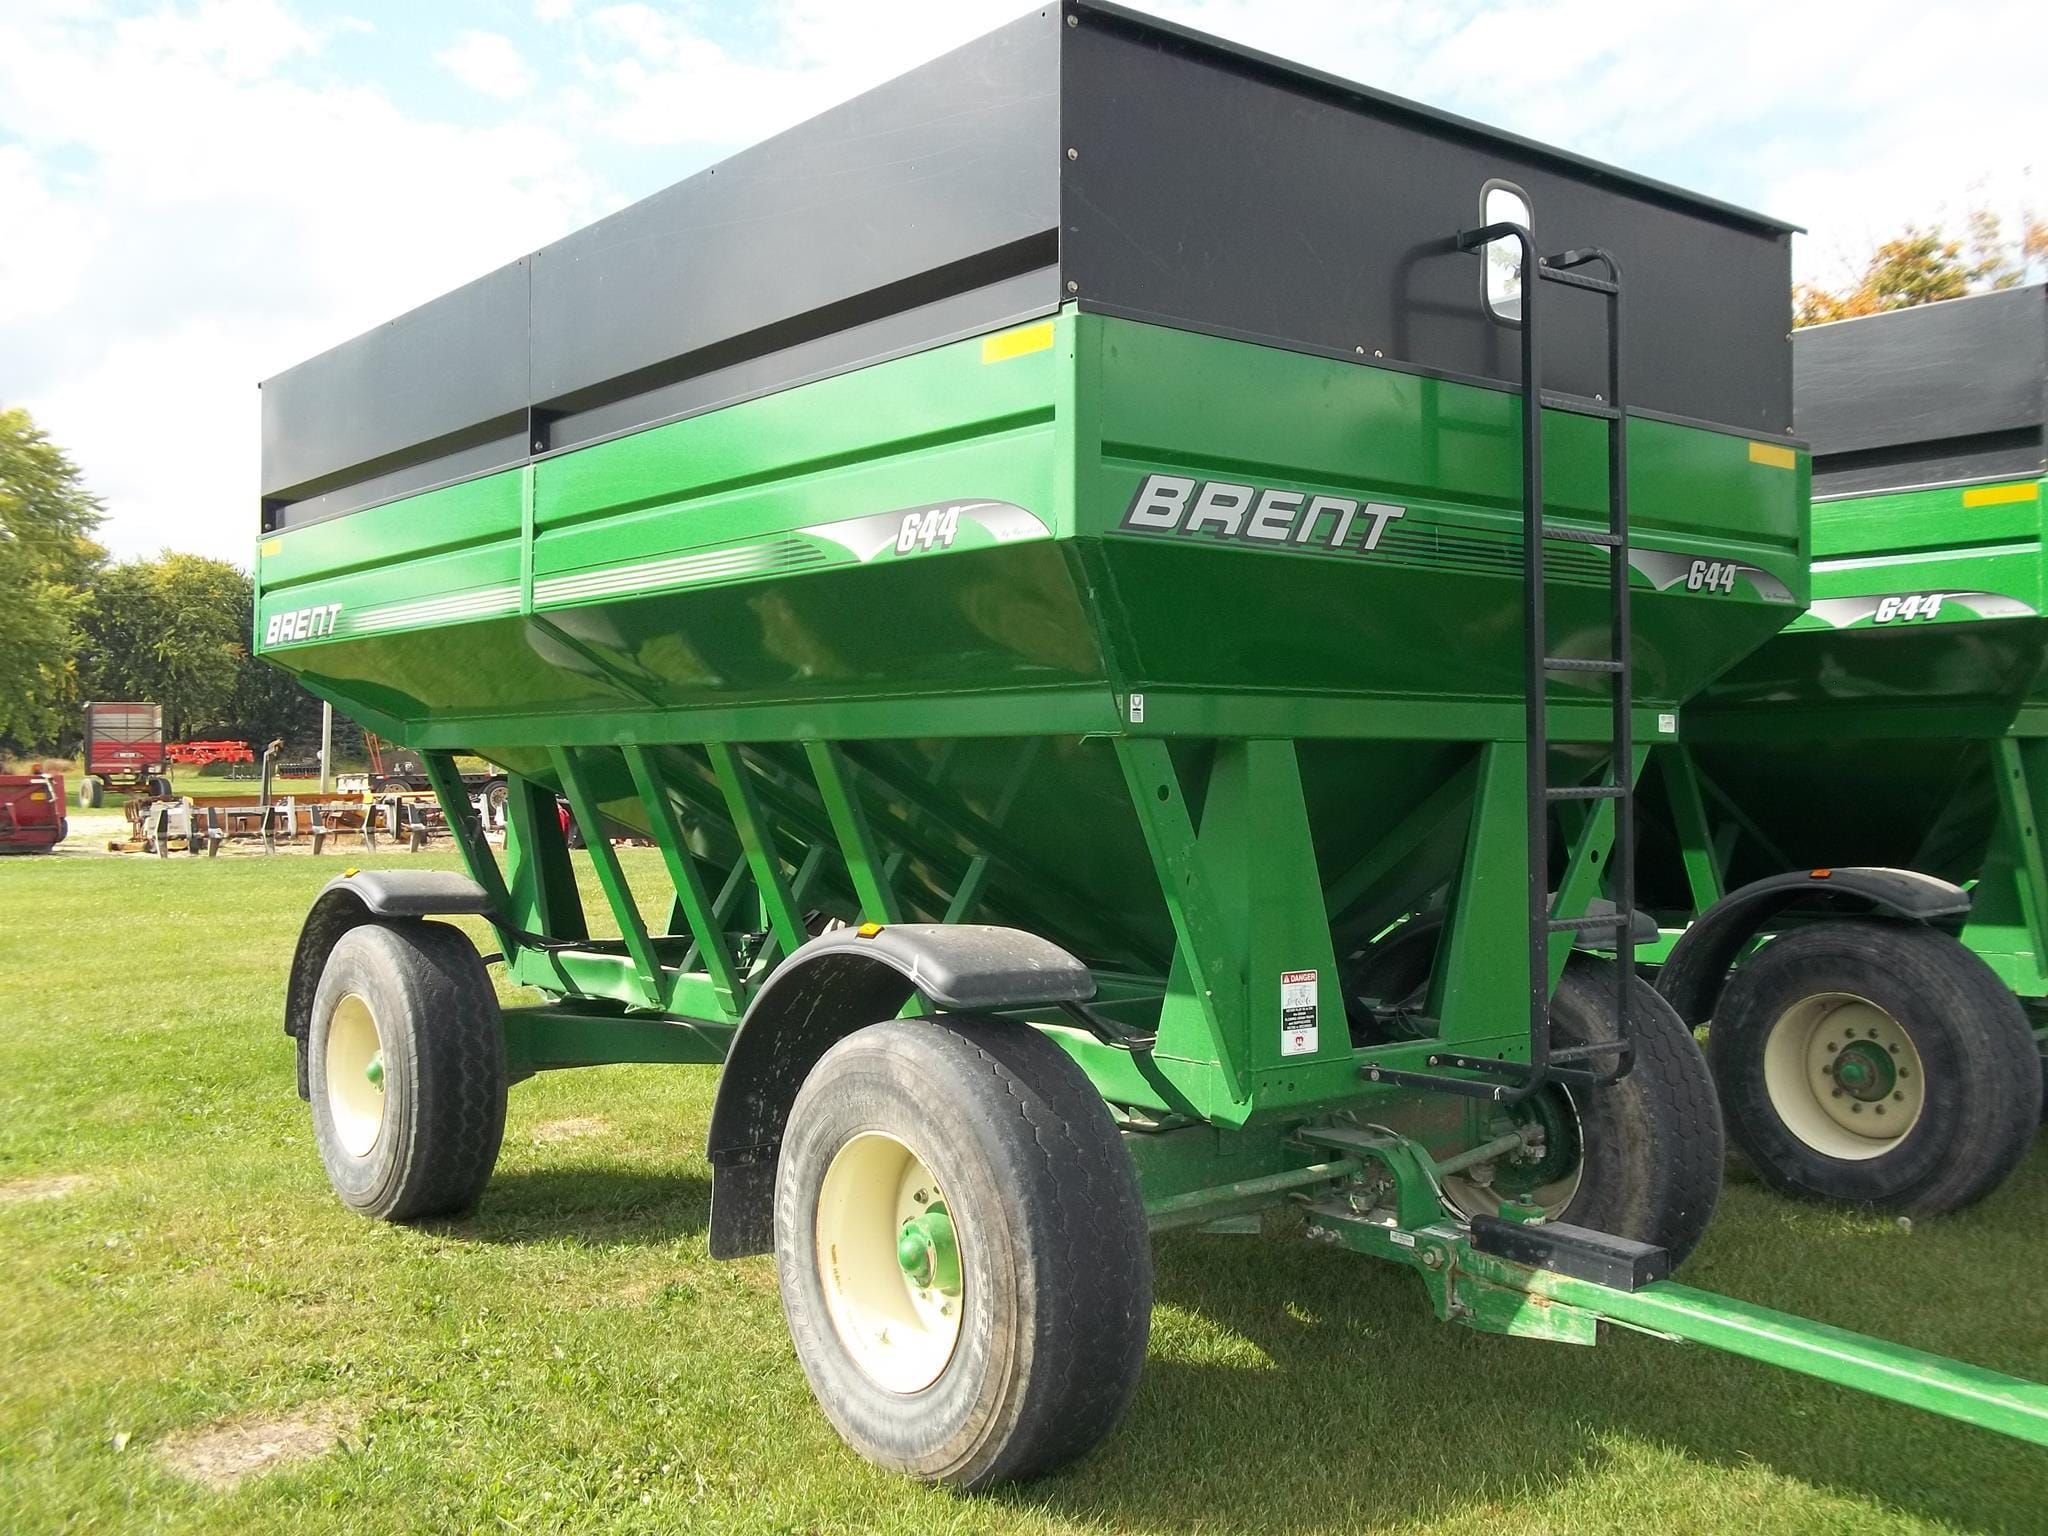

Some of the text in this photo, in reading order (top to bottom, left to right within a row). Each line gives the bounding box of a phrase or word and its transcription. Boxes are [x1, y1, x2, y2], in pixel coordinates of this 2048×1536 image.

[895, 505, 961, 556] 644
[1120, 473, 1407, 554] BRENT
[1686, 560, 1737, 594] 644
[264, 603, 342, 645] BRENT
[1874, 593, 1941, 624] 644
[1290, 972, 1316, 983] DANGER
